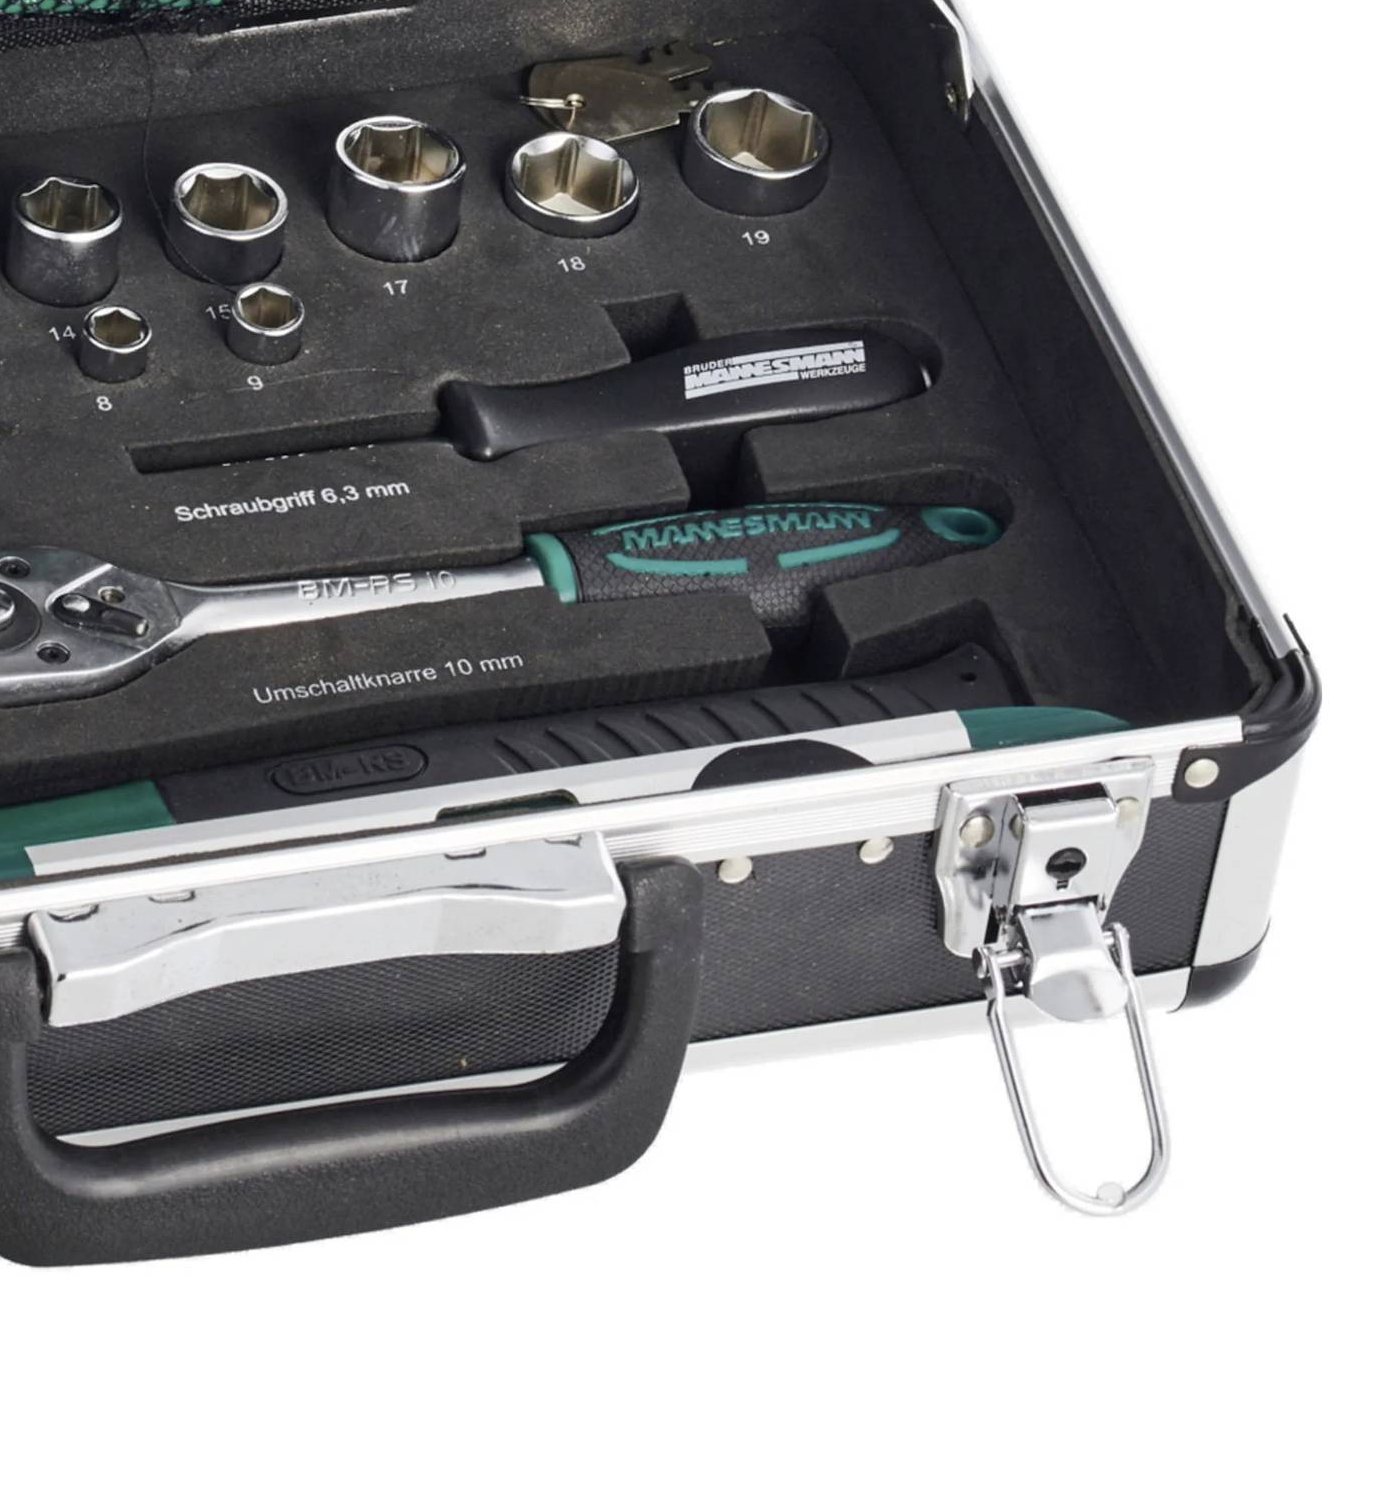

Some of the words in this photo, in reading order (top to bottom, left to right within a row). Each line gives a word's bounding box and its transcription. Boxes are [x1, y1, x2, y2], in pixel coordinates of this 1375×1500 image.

[741, 229, 771, 247] 19
[557, 256, 586, 273] 18
[383, 279, 409, 296] 17
[206, 304, 231, 320] 15
[48, 325, 76, 342] 14
[684, 348, 866, 390] MANNESMANN
[799, 362, 867, 381] WERKZEUGE
[246, 375, 264, 390] 9
[96, 396, 113, 411] 8
[175, 489, 316, 523] Schraubgriff
[320, 484, 359, 504] 6,3
[365, 481, 411, 499] mm
[621, 512, 872, 550] MANNESMANN
[297, 572, 418, 601] BM-RS
[426, 570, 457, 590] 10
[253, 666, 438, 705] Umschaltknarre
[444, 658, 474, 677] 10
[479, 654, 524, 673] mm
